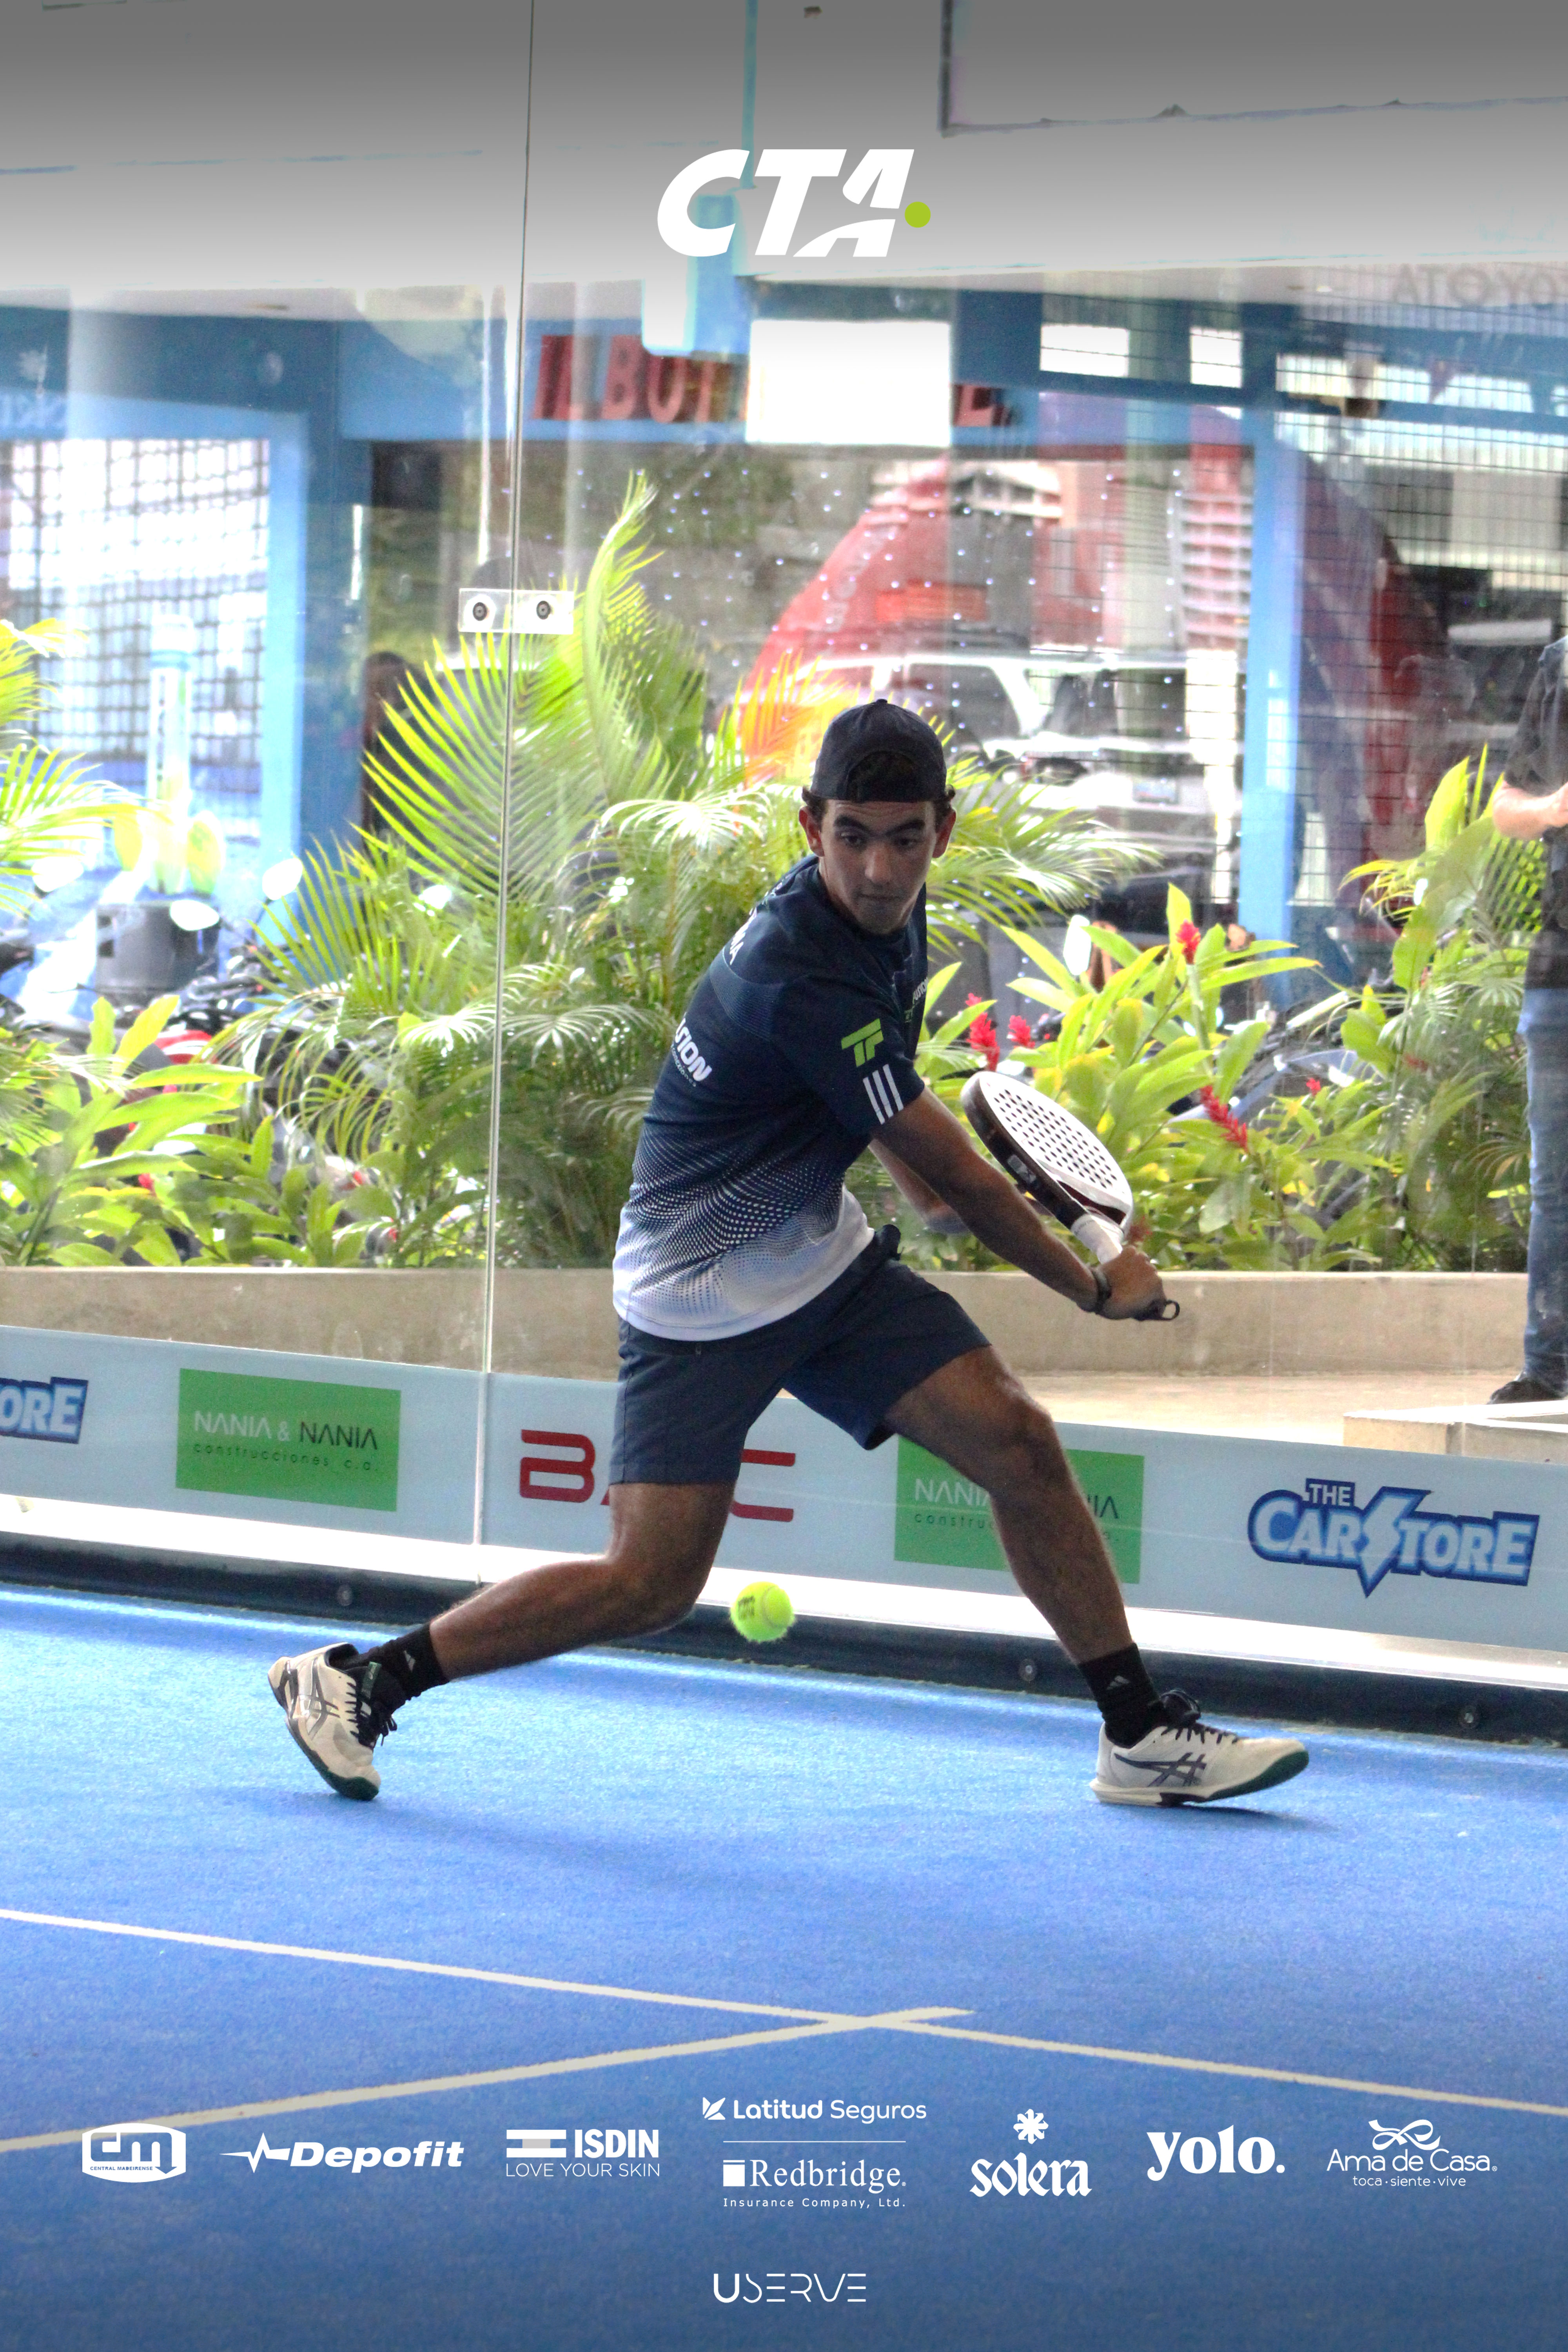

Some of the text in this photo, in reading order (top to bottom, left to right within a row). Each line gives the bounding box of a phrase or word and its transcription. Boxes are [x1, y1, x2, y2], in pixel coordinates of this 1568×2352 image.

[195, 1410, 377, 1450] NANIA & NANIA
[194, 1443, 329, 1466] construcciones
[520, 1429, 796, 1522] BC
[1309, 1483, 1351, 1507] THE
[915, 1513, 993, 1529] constru
